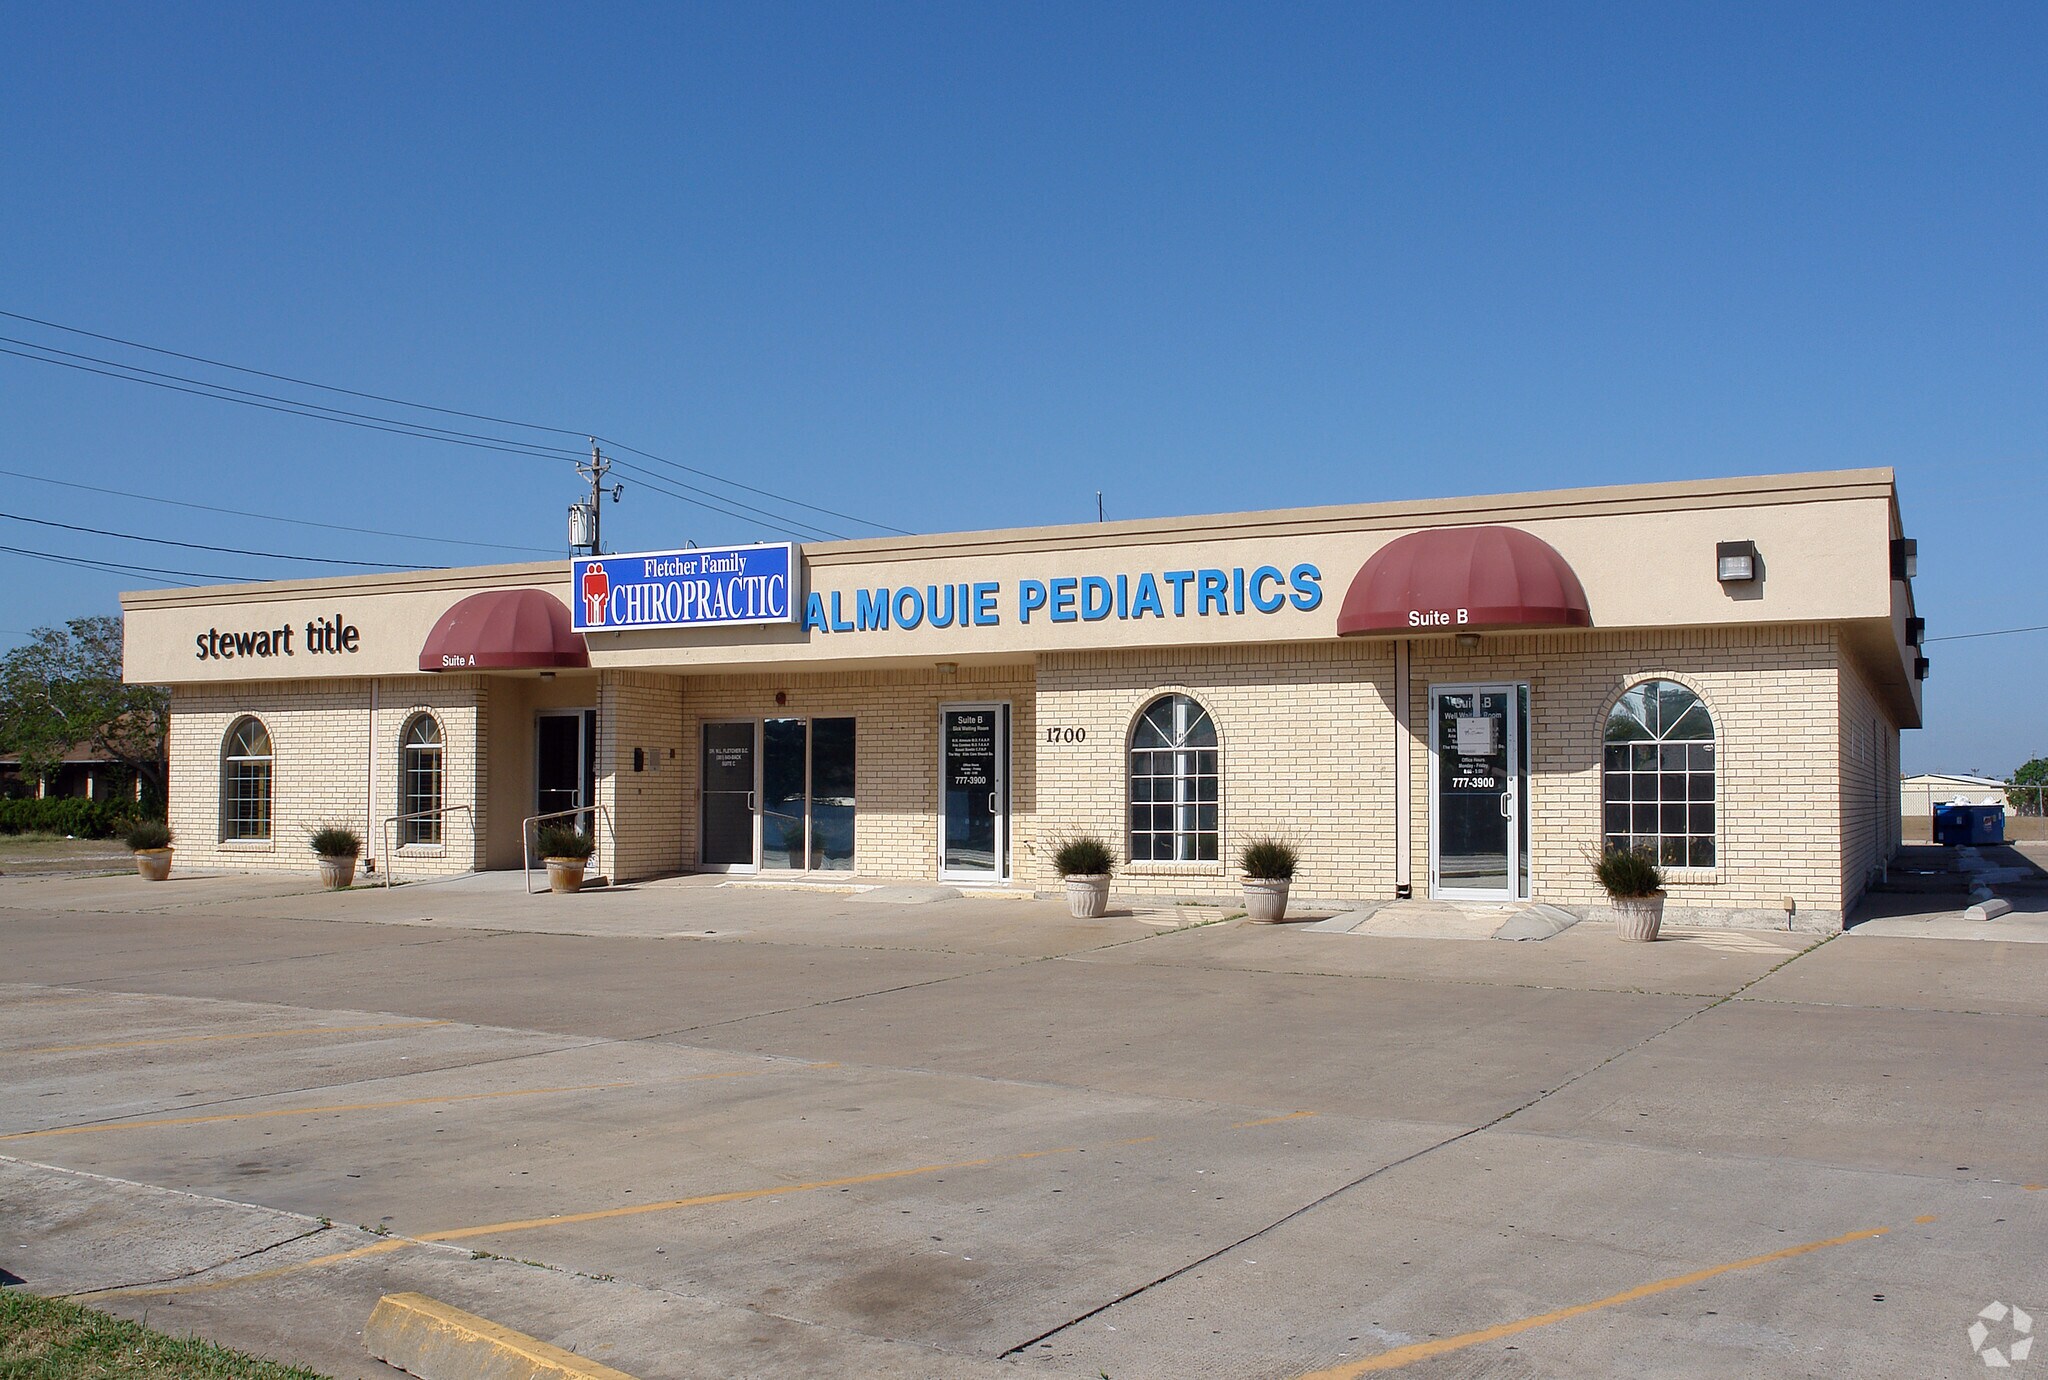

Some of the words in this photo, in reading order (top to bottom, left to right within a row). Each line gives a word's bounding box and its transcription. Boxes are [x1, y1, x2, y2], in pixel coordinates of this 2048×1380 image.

[644, 557, 698, 578] Fletcher
[700, 552, 747, 575] Family
[611, 574, 784, 625] CHIROPRACTIC
[801, 581, 1001, 633] ALMOUIE
[1018, 563, 1323, 625] PEDIATRICS
[1408, 610, 1450, 627] Suite
[1456, 608, 1469, 625] B
[196, 624, 295, 660] stewart
[305, 613, 360, 654] title
[442, 654, 466, 667] Suite
[468, 654, 476, 666] A
[957, 716, 976, 724] Suite
[977, 716, 983, 724] B
[1046, 727, 1086, 743] 1700
[955, 776, 987, 785] 777-3900
[1452, 777, 1495, 788] 777-3900
